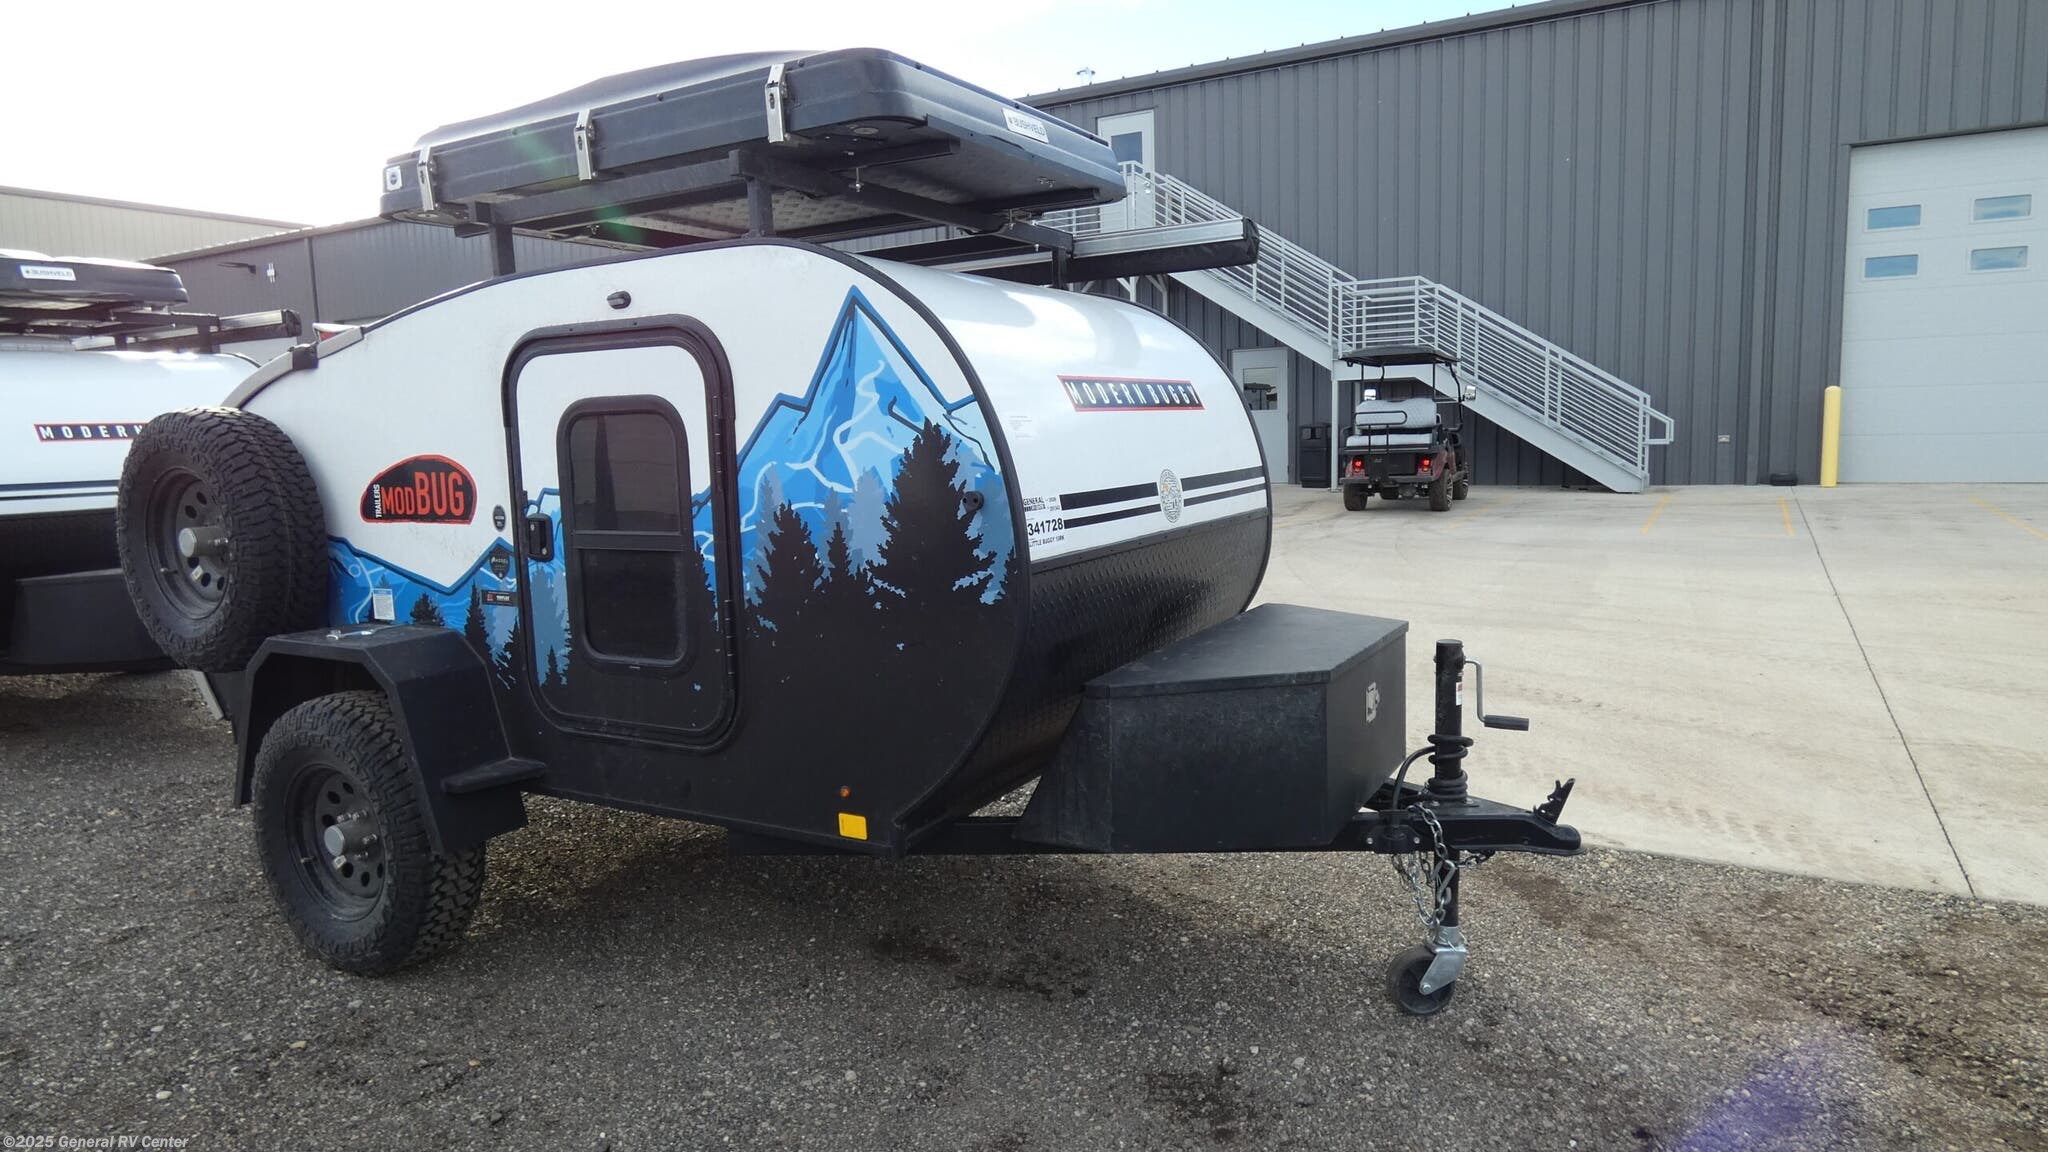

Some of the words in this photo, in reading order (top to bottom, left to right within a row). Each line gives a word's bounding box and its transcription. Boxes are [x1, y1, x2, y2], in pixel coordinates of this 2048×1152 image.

[1065, 381, 1147, 404] MODERN
[1147, 384, 1199, 404] BUGGY
[373, 484, 382, 518] TRAILERS
[1028, 518, 1063, 536] 341728
